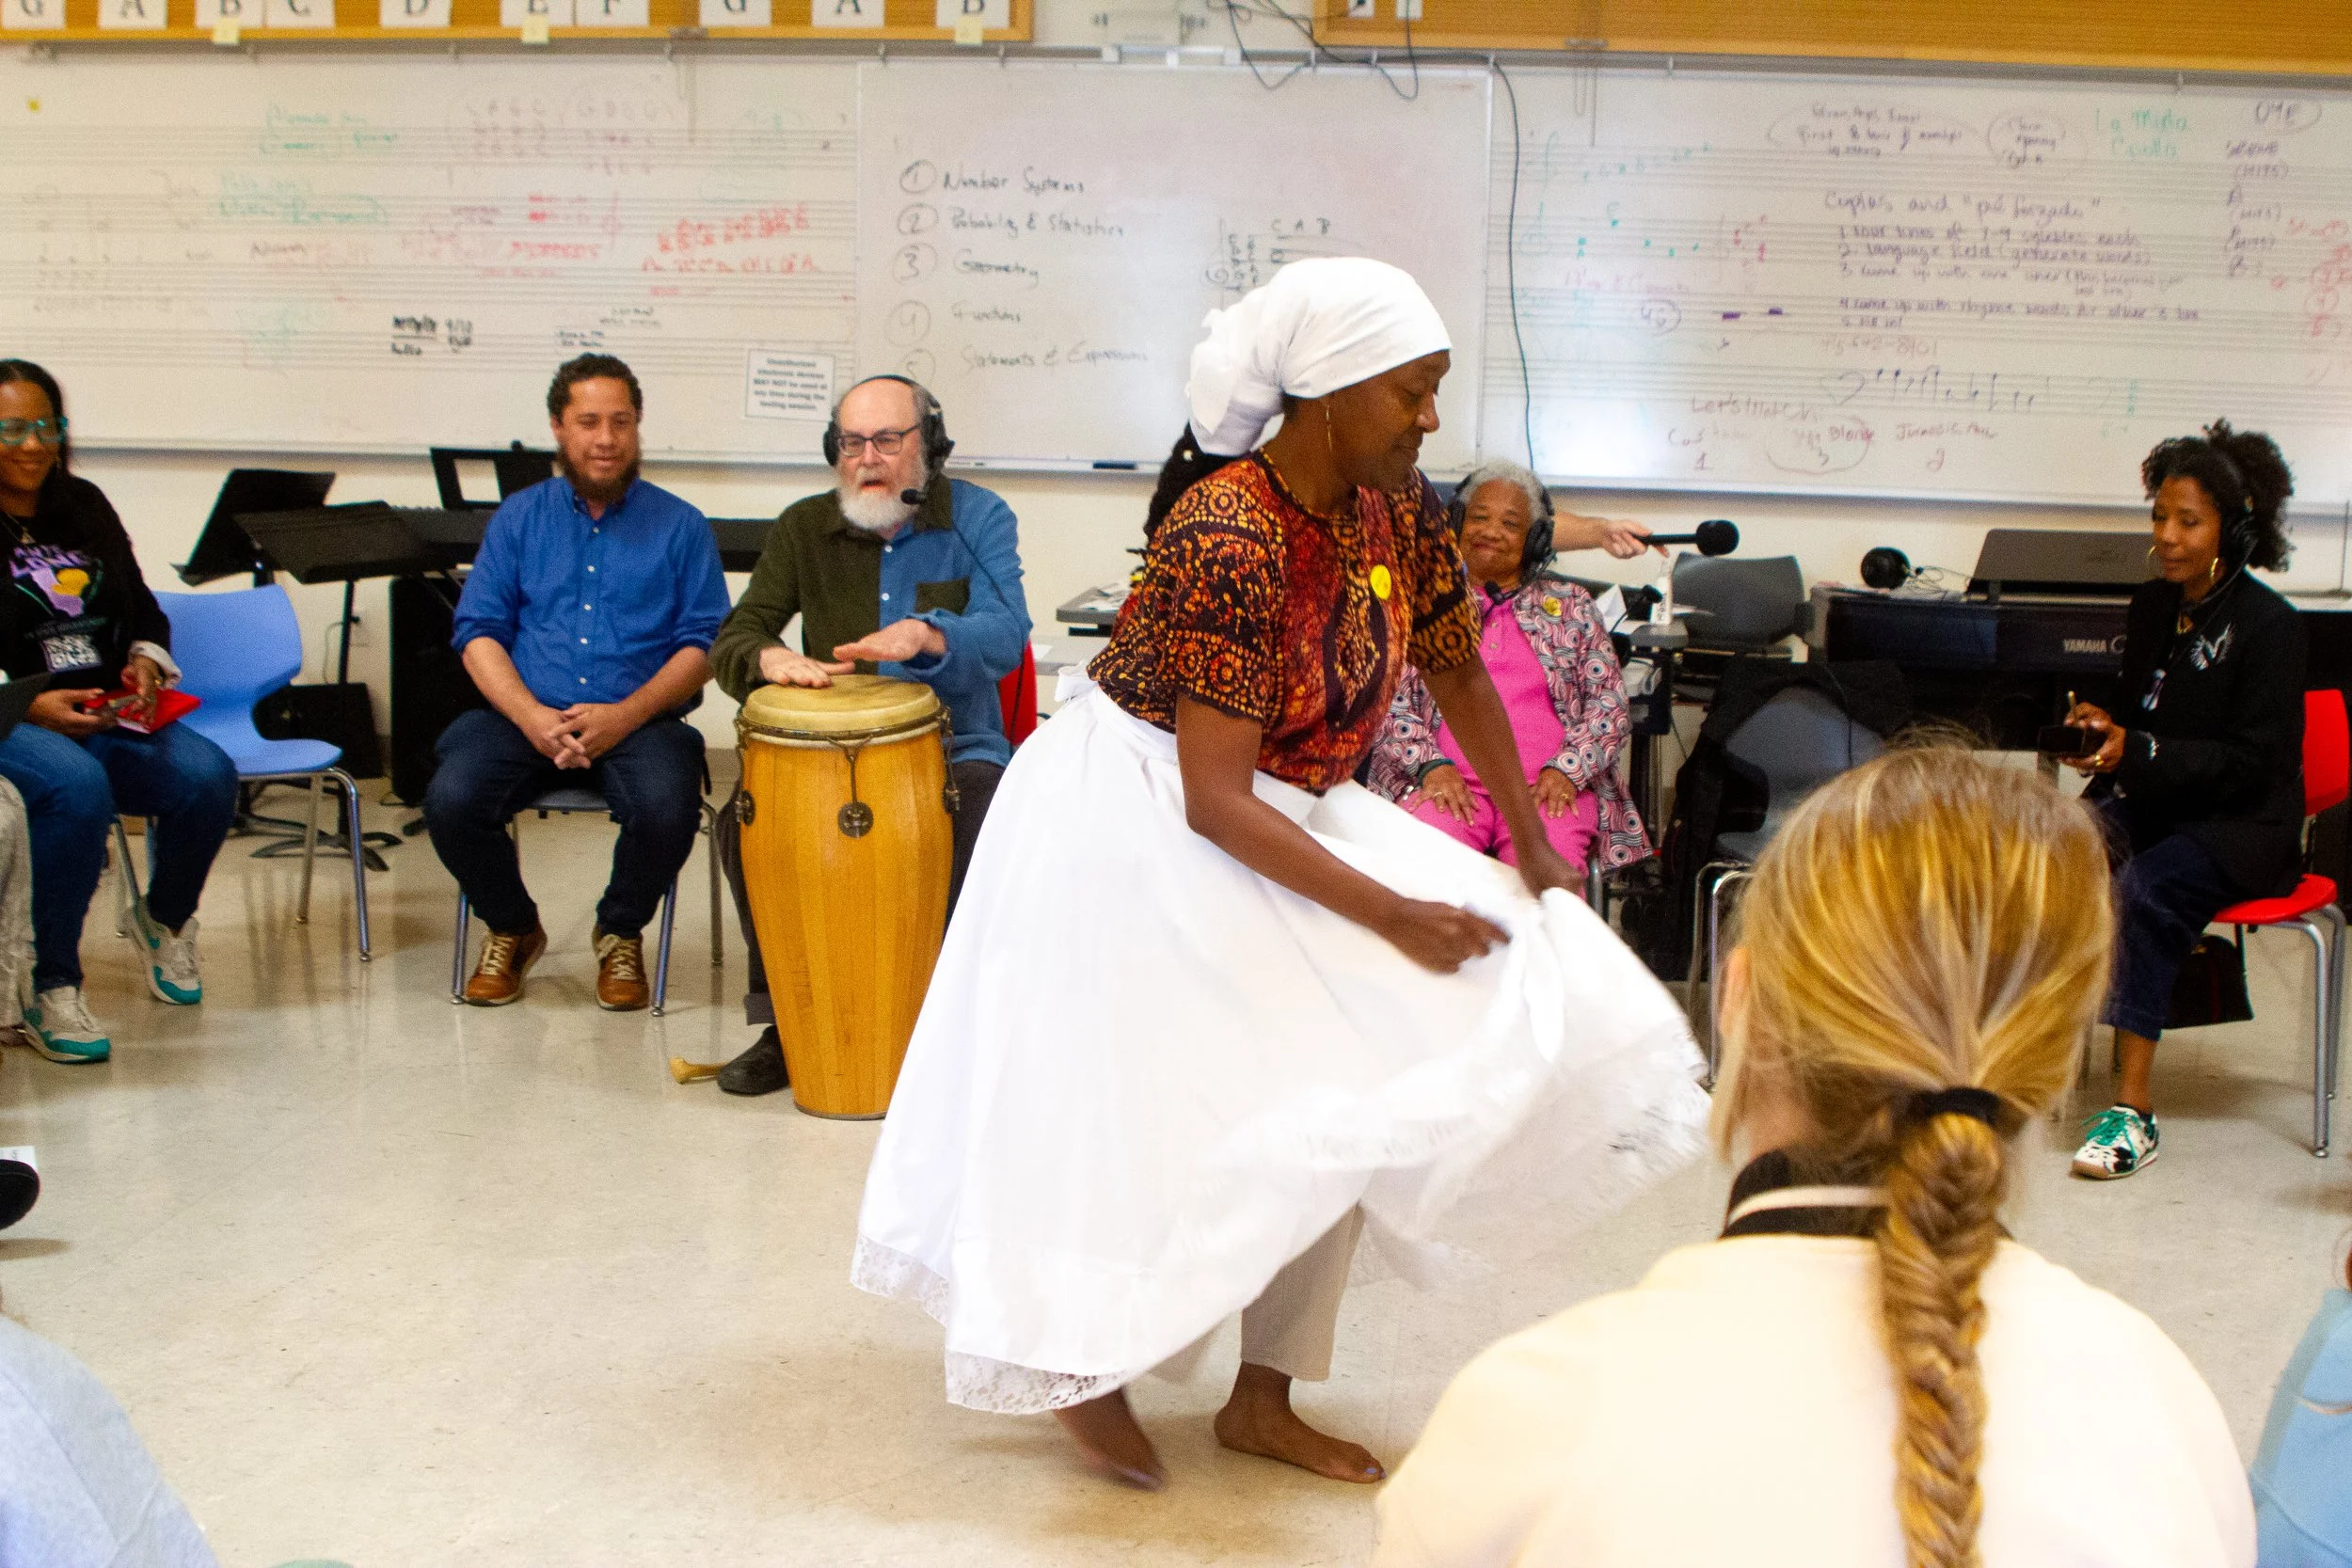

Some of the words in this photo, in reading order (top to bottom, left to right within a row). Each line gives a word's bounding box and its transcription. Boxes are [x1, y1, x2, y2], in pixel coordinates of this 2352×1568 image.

[943, 166, 1008, 189] Number
[1022, 166, 1086, 197] Systems
[1907, 194, 1950, 213] and
[2064, 639, 2107, 654] YAMAHA
